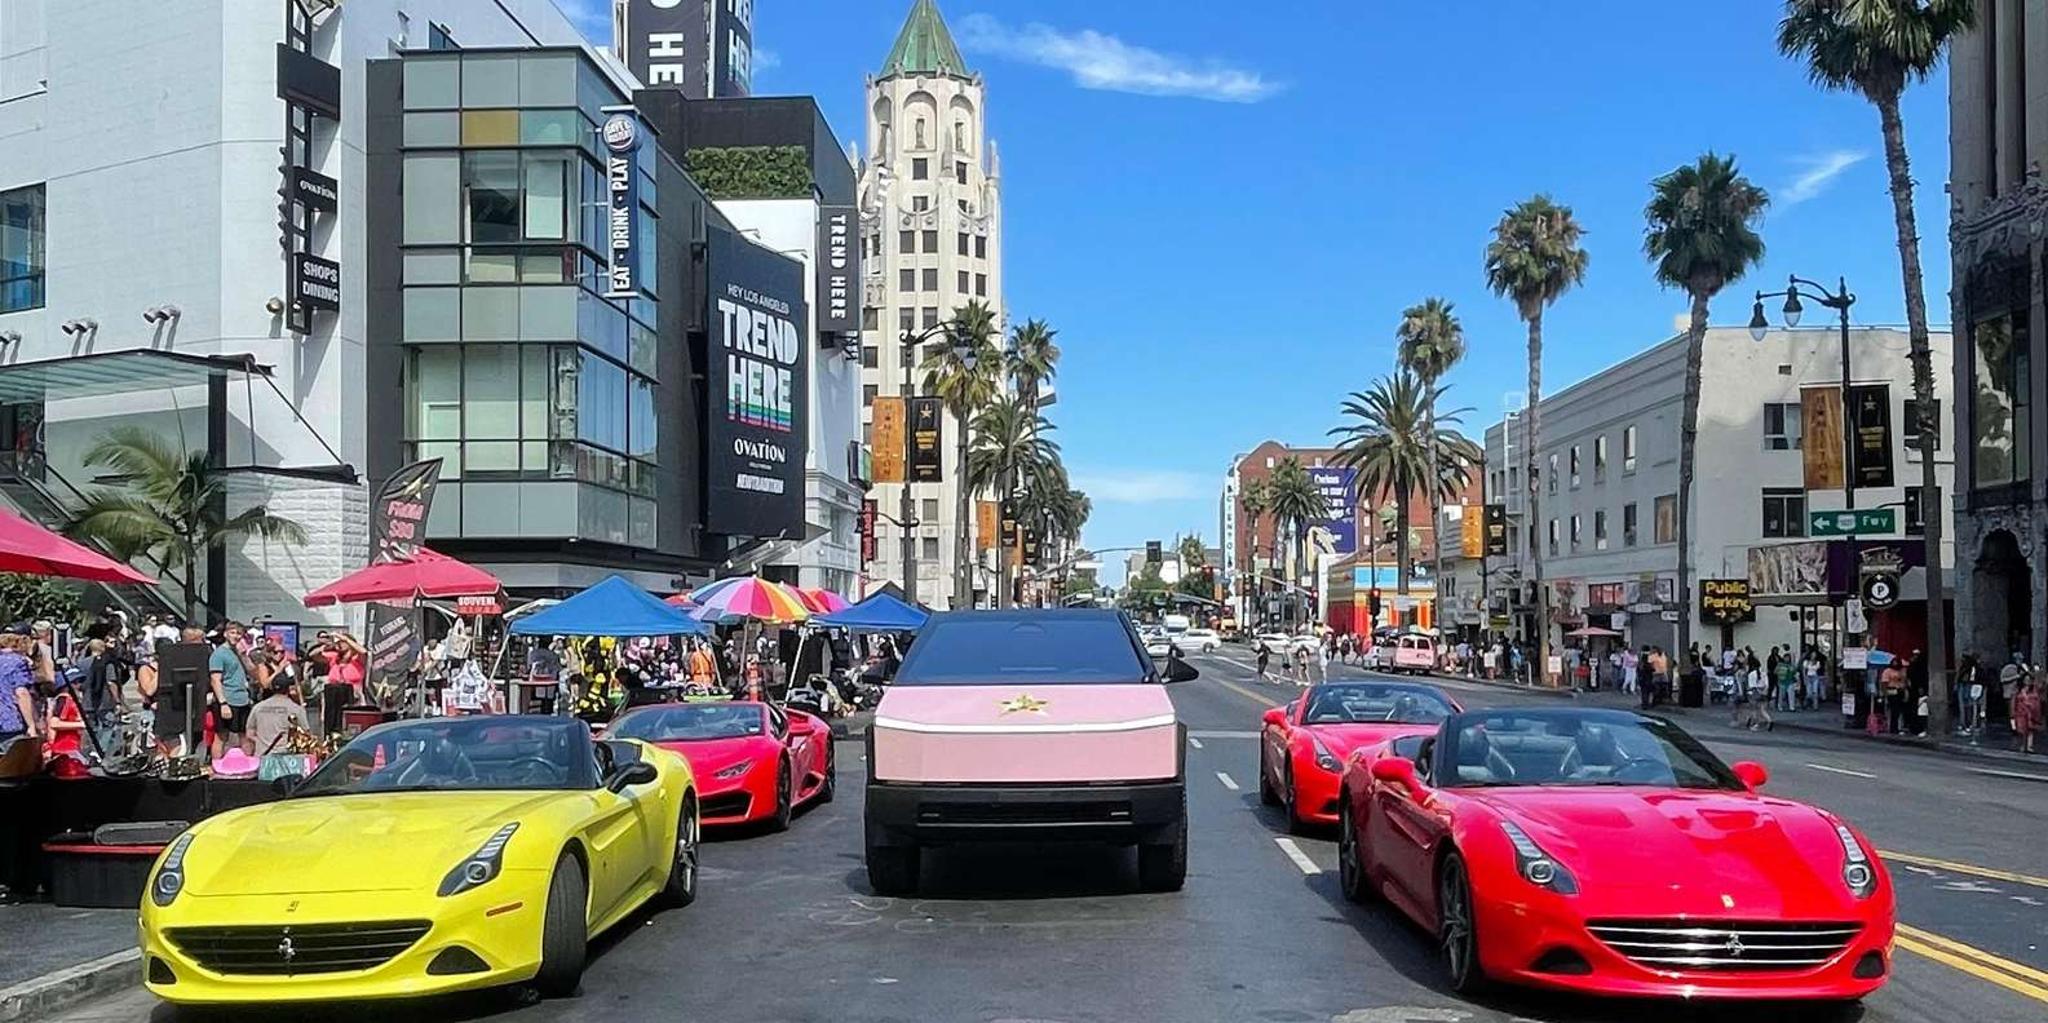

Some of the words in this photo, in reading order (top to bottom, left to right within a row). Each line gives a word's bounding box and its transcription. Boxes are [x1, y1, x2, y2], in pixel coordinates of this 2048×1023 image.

[611, 157, 629, 191] PLAY
[613, 206, 630, 249] DRINK
[831, 215, 847, 269] TREND
[303, 261, 338, 283] SHOPS
[613, 266, 630, 290] EAT
[302, 281, 339, 303] DINING
[727, 283, 744, 299] HEY
[743, 289, 759, 305] LOS
[759, 294, 790, 315] ANGELES
[831, 276, 847, 319] HERE
[718, 298, 799, 365] TREND
[728, 354, 792, 432] HERE
[1703, 596, 1752, 612] Parking
[1705, 581, 1748, 594] Public
